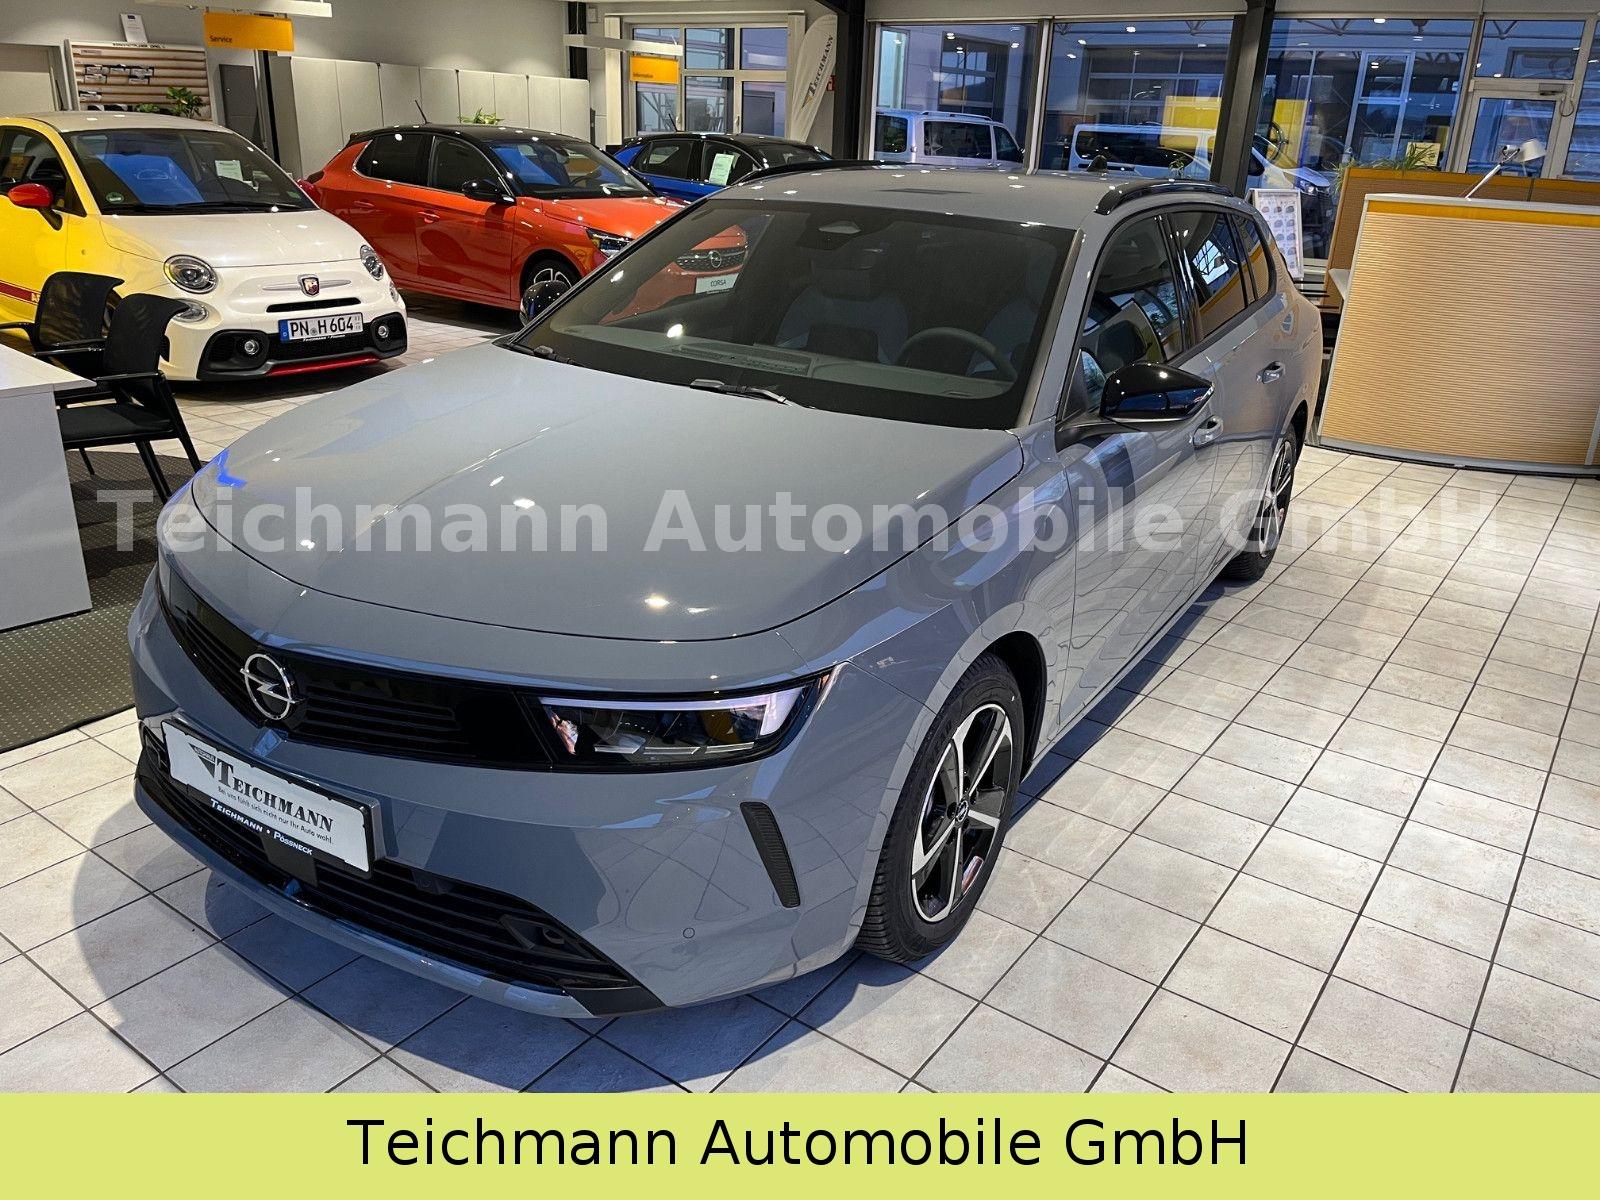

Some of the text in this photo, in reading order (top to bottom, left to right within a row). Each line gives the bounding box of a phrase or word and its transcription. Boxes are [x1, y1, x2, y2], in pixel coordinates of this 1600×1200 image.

[210, 35, 233, 44] Service
[809, 34, 834, 97] TEICHMANN
[289, 320, 310, 337] PN
[317, 319, 328, 334] H
[329, 316, 354, 333] 604
[216, 757, 334, 833] TEICHMANN
[210, 797, 263, 833] TEICHMANN
[278, 815, 289, 825] nur
[290, 820, 300, 831] Ihr
[300, 824, 316, 837] Auto
